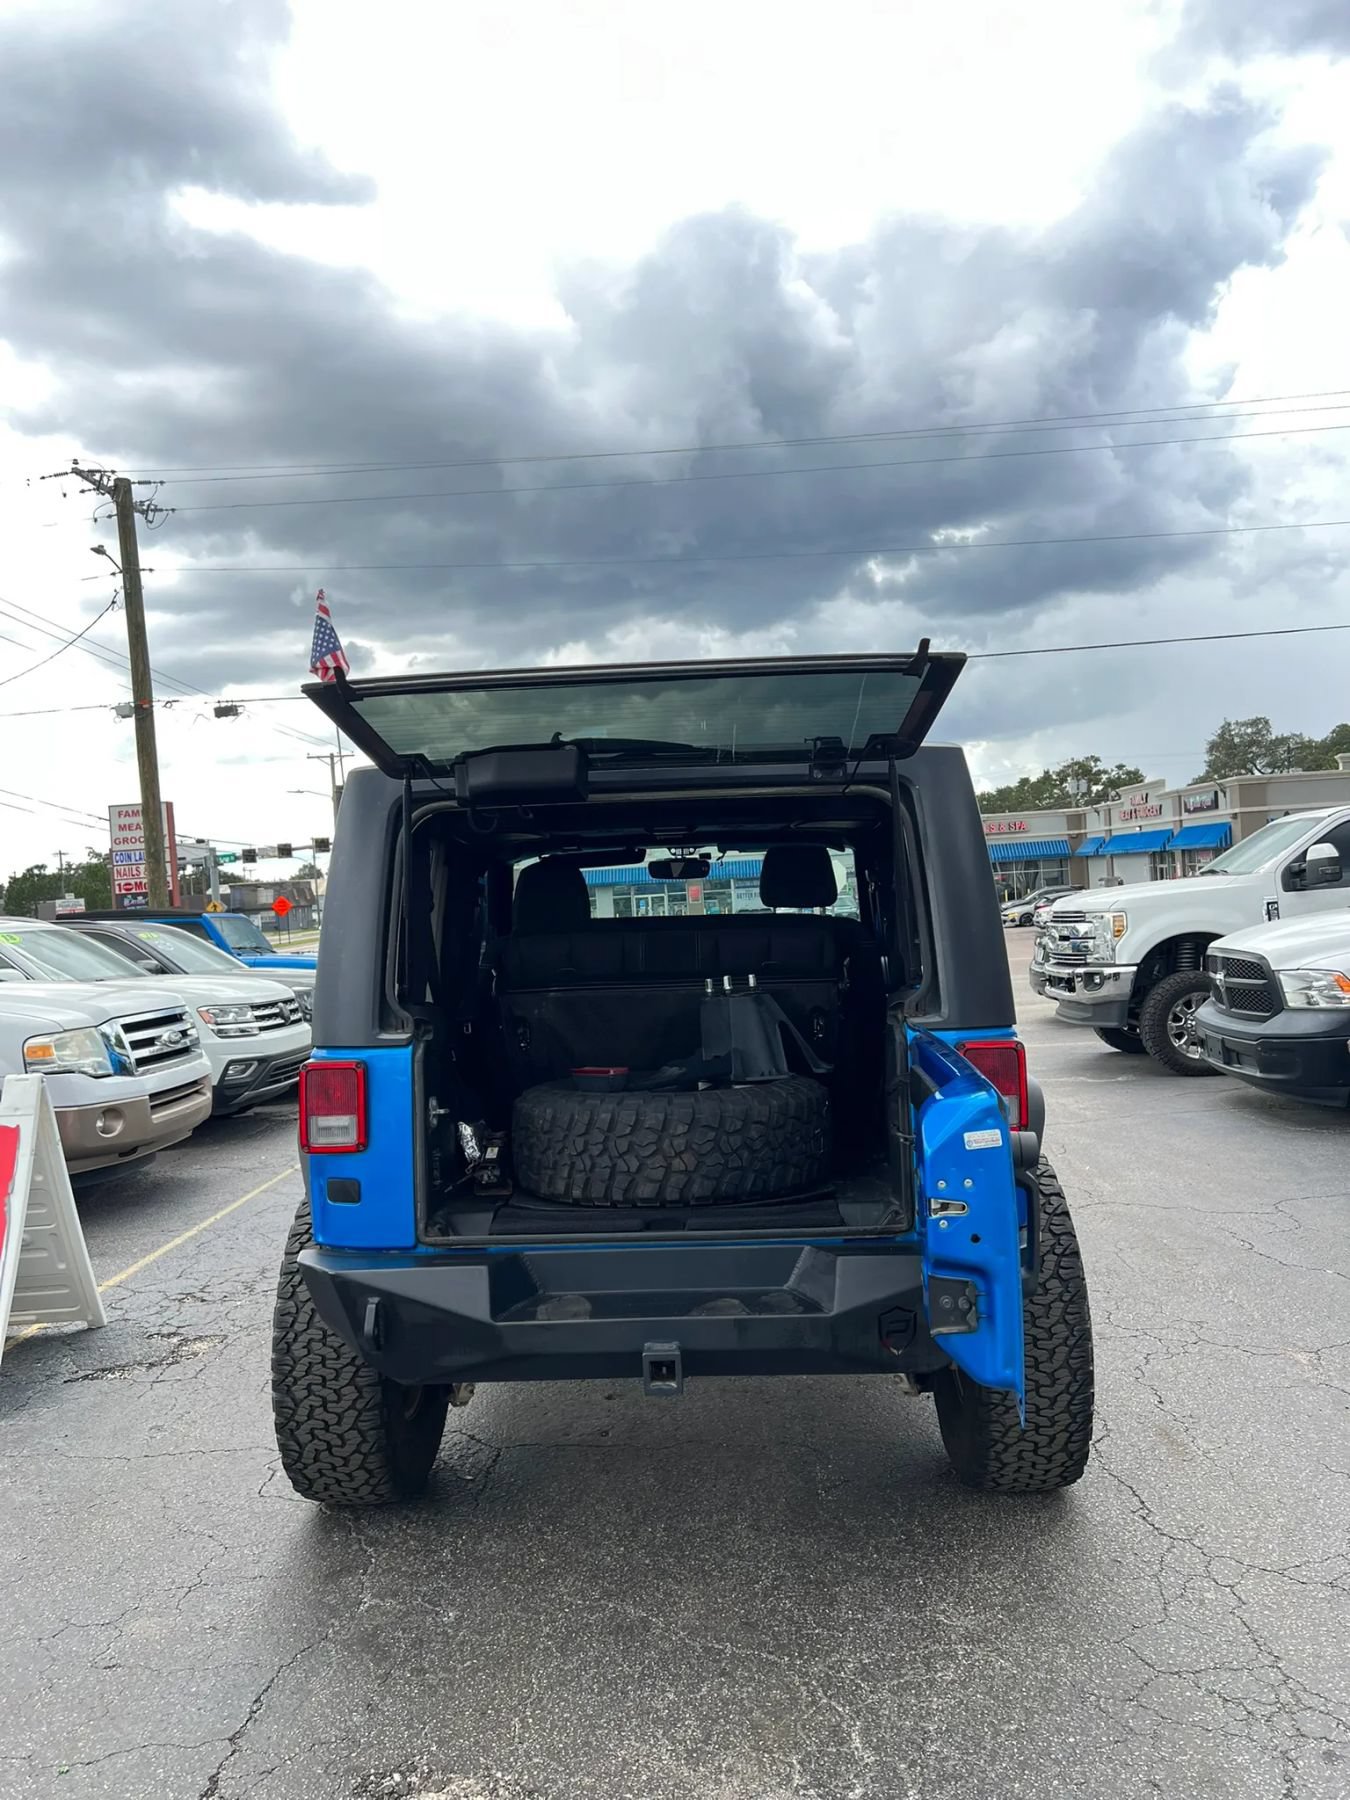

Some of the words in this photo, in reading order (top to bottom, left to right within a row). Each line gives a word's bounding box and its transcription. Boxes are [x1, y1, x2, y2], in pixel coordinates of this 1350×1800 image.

[118, 810, 143, 818] FAM
[118, 823, 144, 832] MEA
[1008, 821, 1026, 832] SPA
[113, 836, 145, 846] GROC
[114, 852, 132, 864] COIN
[115, 866, 141, 879] NAILS
